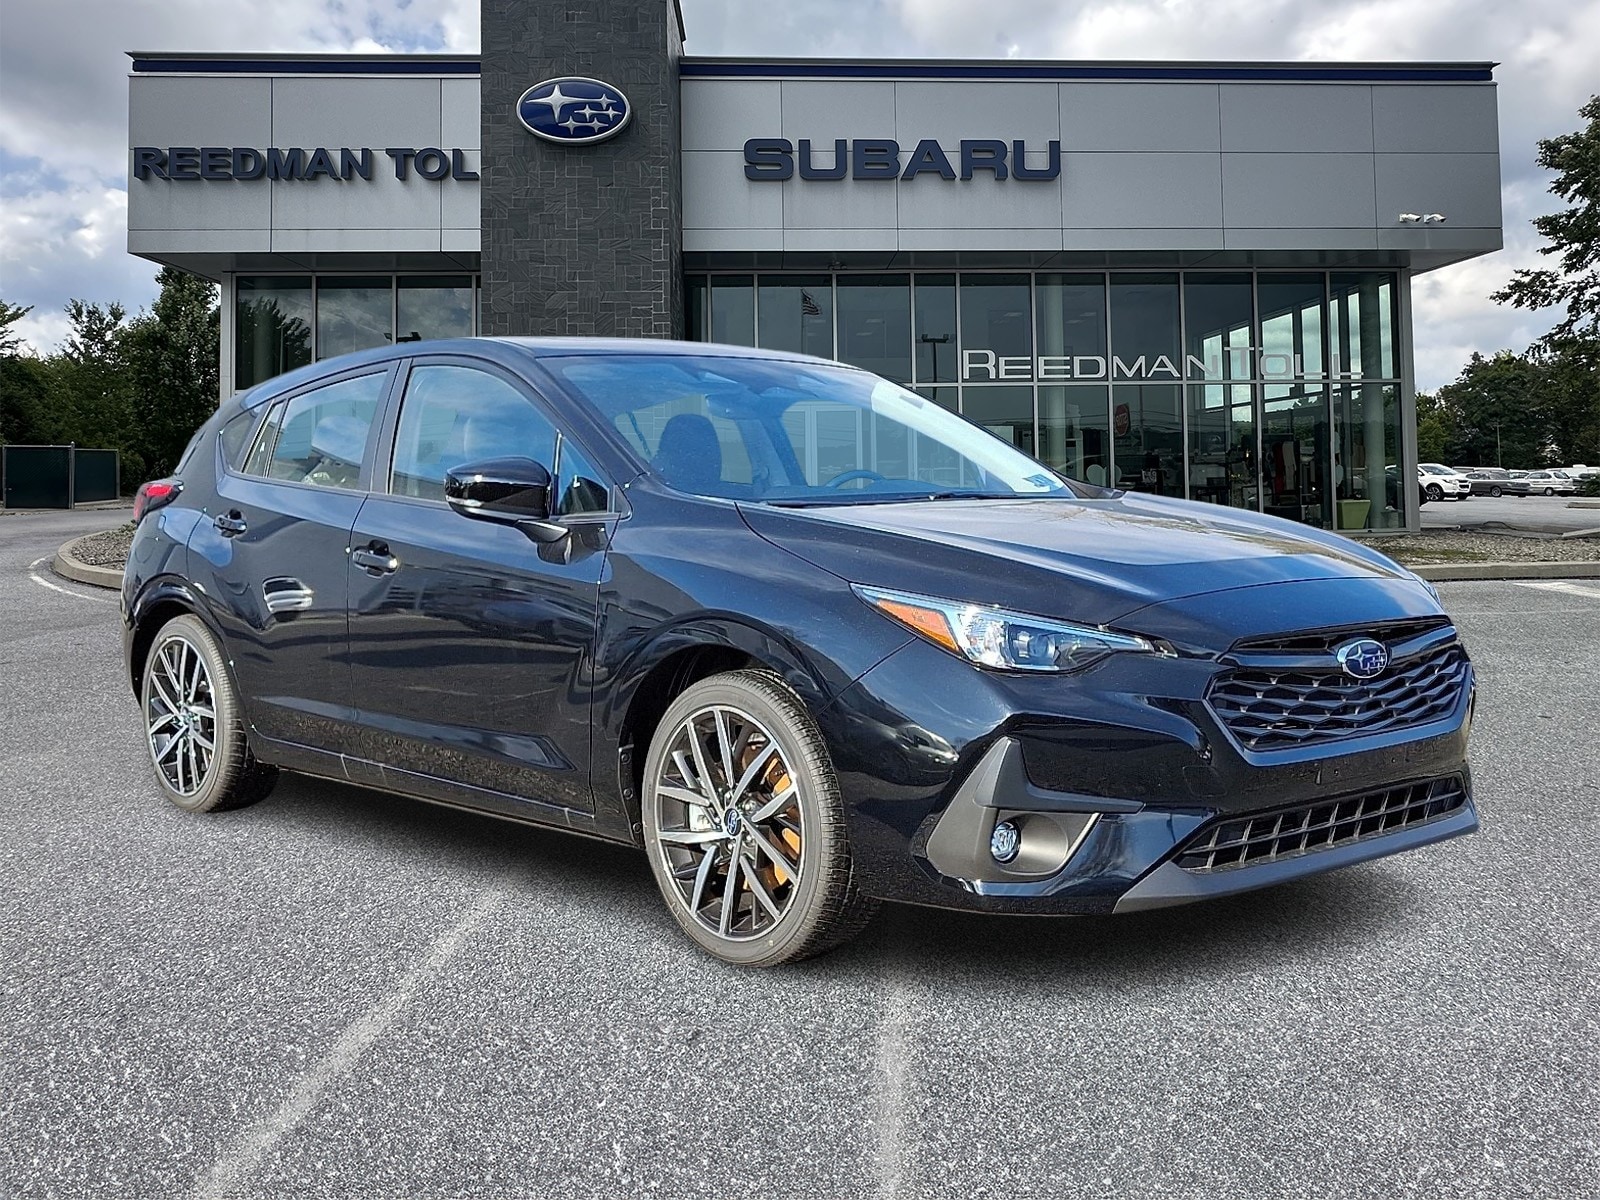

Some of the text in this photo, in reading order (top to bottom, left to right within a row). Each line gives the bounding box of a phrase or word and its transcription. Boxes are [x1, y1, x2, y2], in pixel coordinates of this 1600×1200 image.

[132, 147, 480, 182] REEDMAN TOL
[743, 138, 1062, 181] SUBARU
